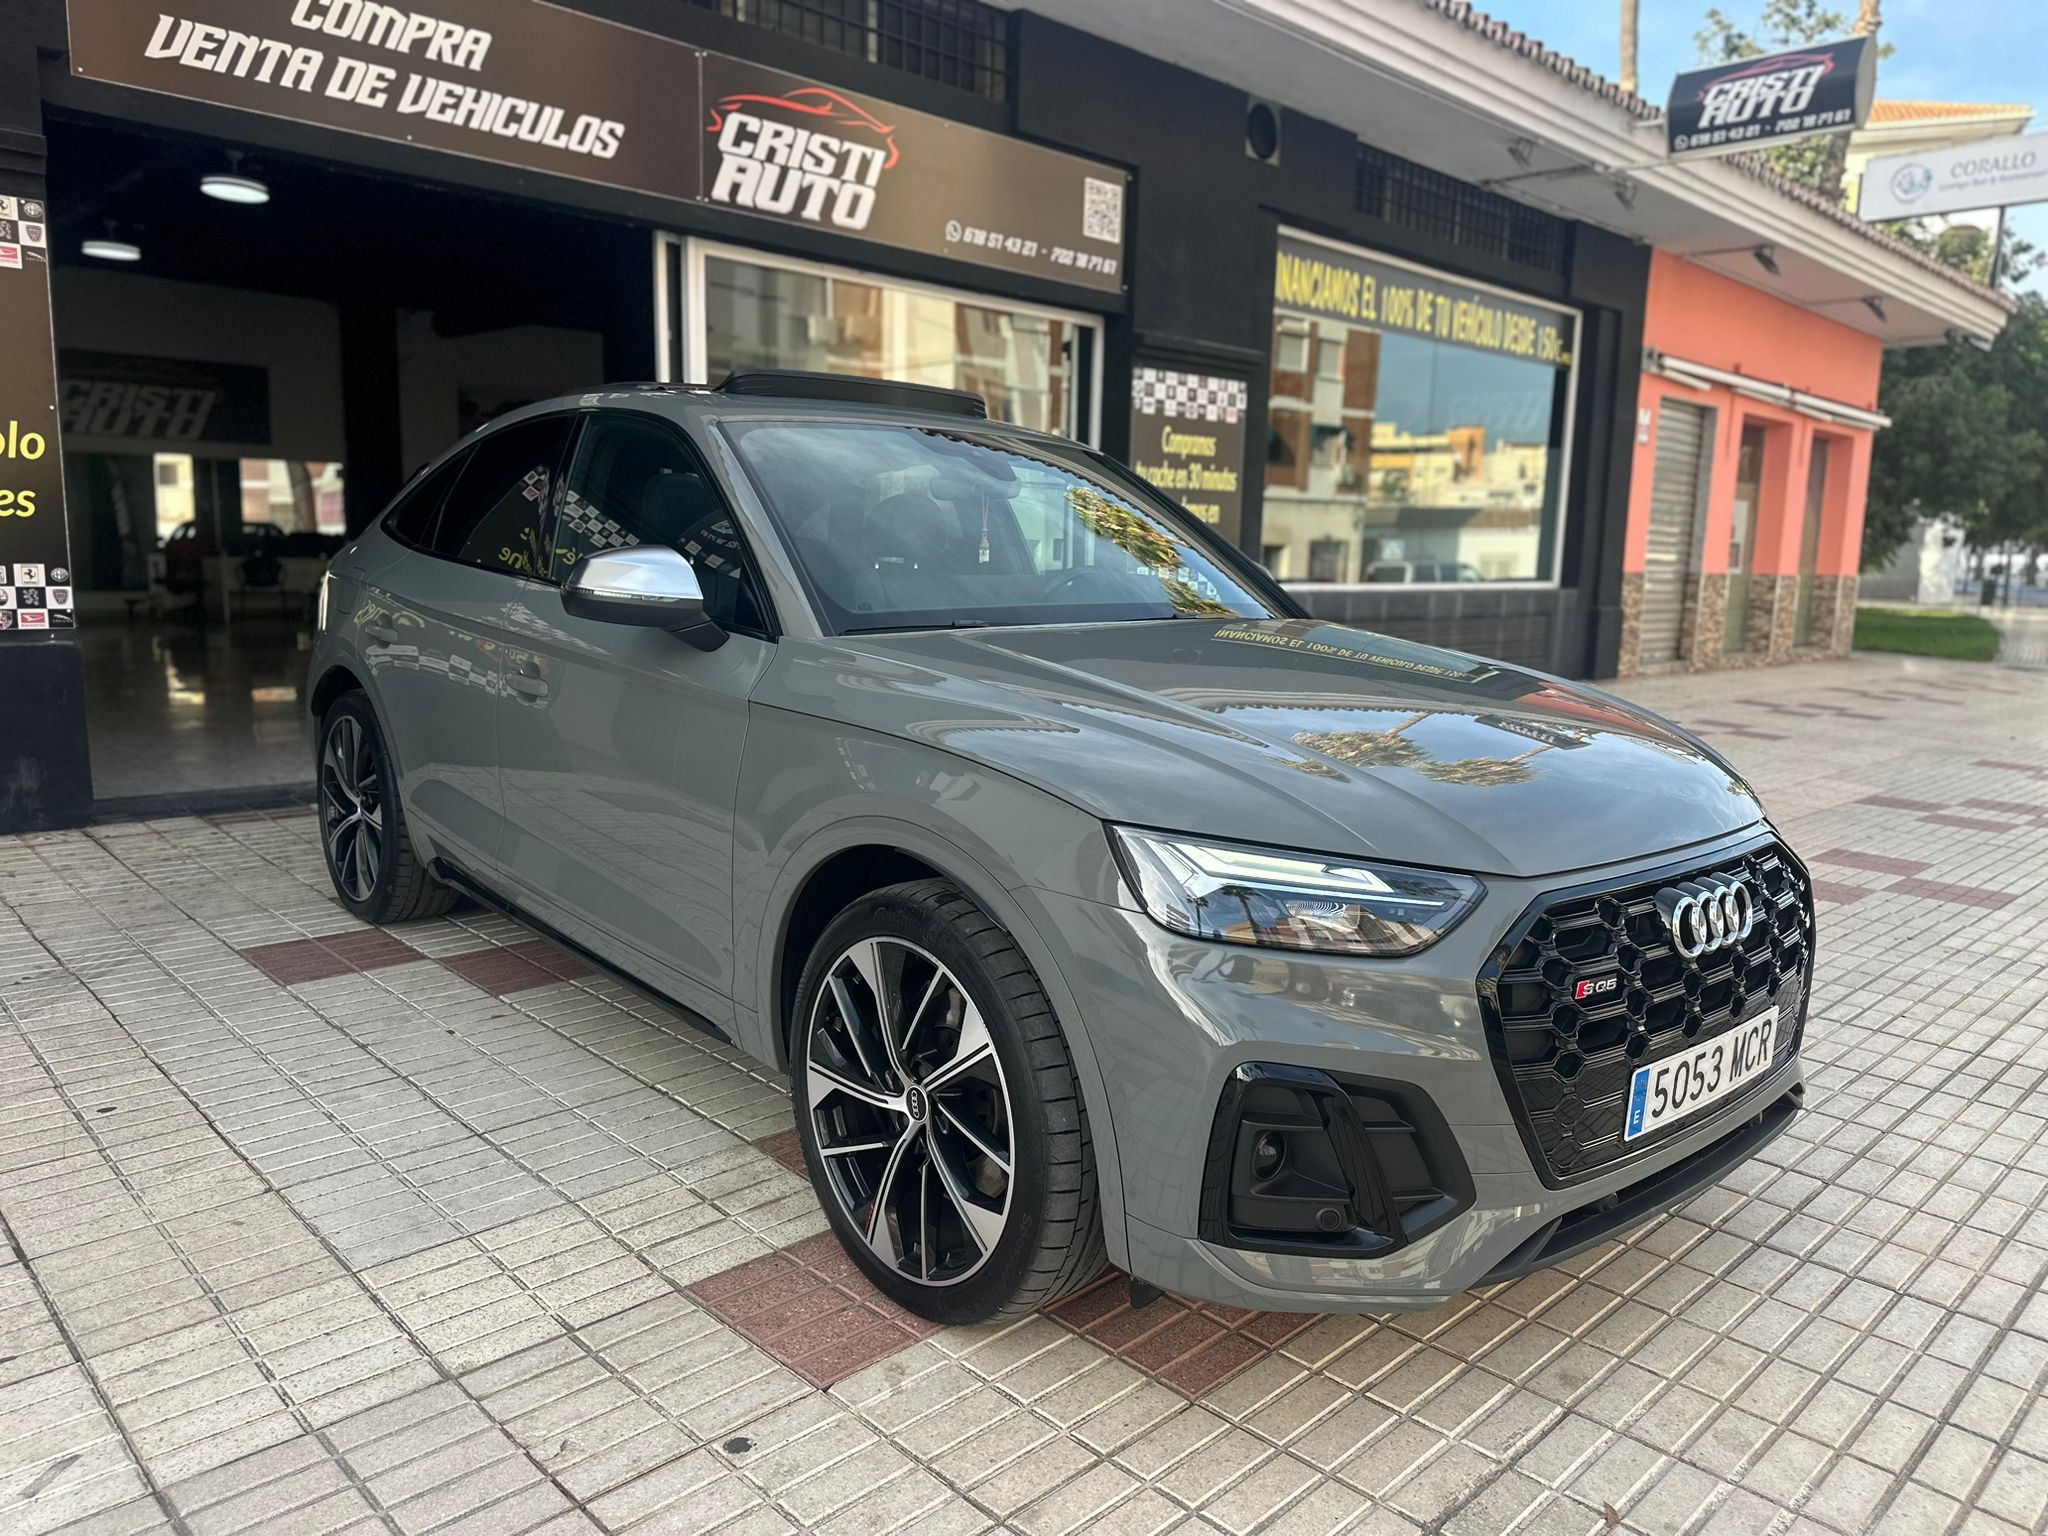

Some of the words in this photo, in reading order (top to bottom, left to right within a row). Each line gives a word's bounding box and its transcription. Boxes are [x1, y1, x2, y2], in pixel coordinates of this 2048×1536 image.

[290, 0, 492, 71] COMPRA
[144, 14, 329, 92] VENTA
[325, 57, 396, 107] DE
[396, 74, 625, 159] VEHICULOS
[1703, 64, 1825, 106] CRISTI
[1697, 86, 1815, 129] AUTO
[718, 112, 887, 187] CRISTI
[1950, 151, 2037, 179] CORALLO
[711, 153, 876, 230] AUTO
[1361, 275, 1377, 321] EL
[1381, 286, 1414, 328] 100%
[1416, 288, 1433, 333] DE
[1435, 295, 1452, 338] TU
[1452, 294, 1503, 350] VEHÍCULO
[1503, 311, 1537, 356] DESDE
[0, 420, 46, 460] lo
[1161, 425, 1217, 460] Compramos
[1202, 463, 1238, 492] minutos
[1583, 978, 1617, 995] SQ5
[1651, 1045, 1723, 1118] 5053
[1729, 1018, 1771, 1082] MCR
[1632, 1109, 1641, 1125] E
